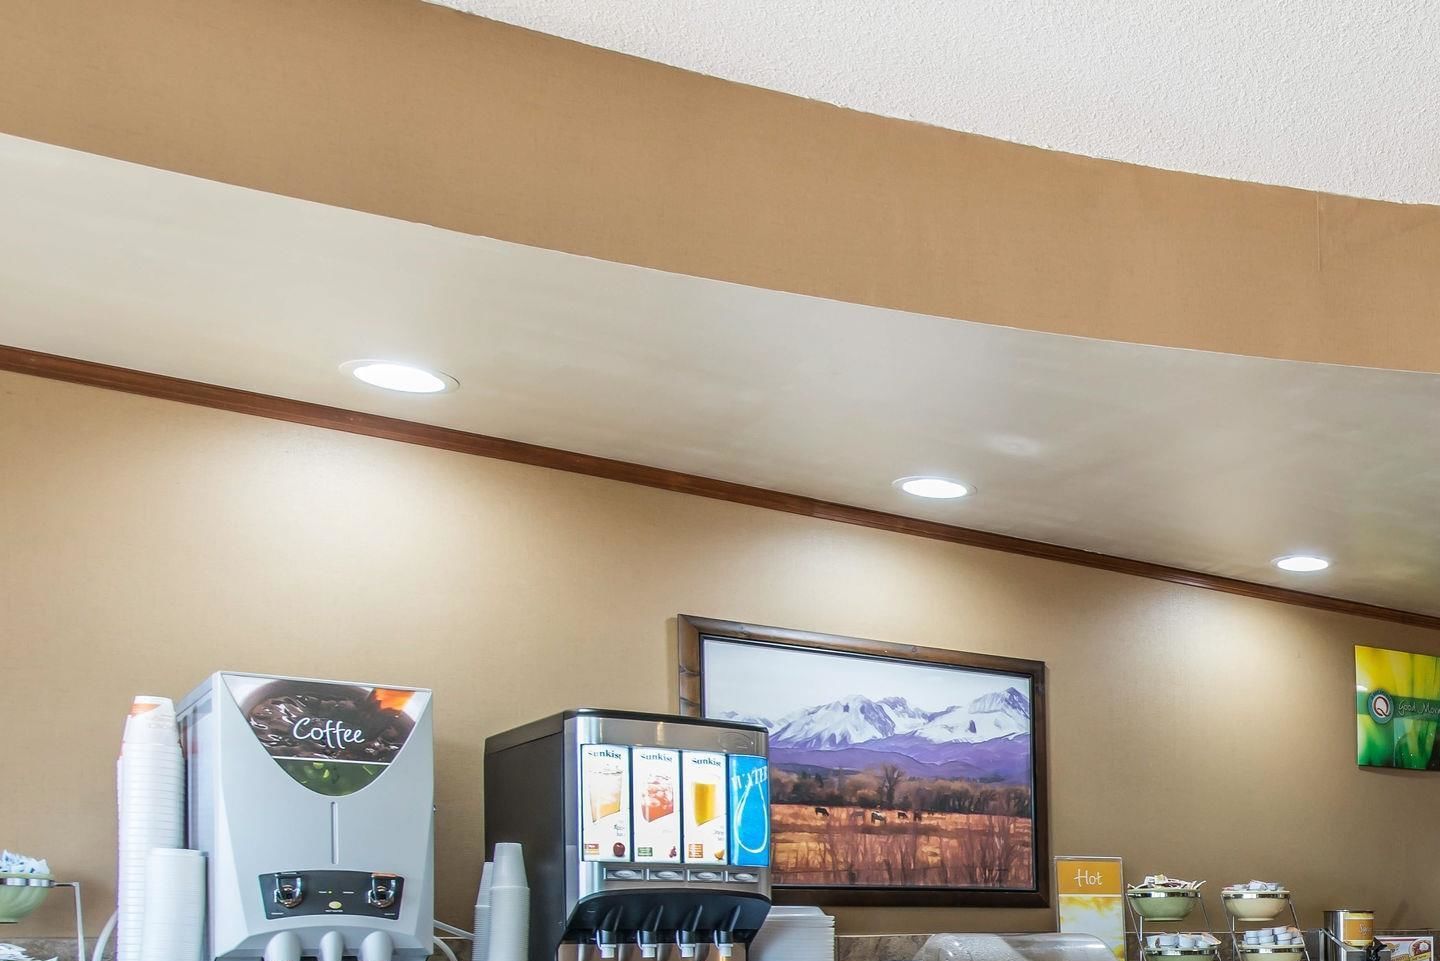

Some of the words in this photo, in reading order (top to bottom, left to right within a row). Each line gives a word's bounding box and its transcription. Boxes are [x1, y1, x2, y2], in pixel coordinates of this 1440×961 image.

[1398, 699, 1416, 716] Good
[293, 717, 365, 749] Coffee
[1073, 868, 1103, 888] Hot
